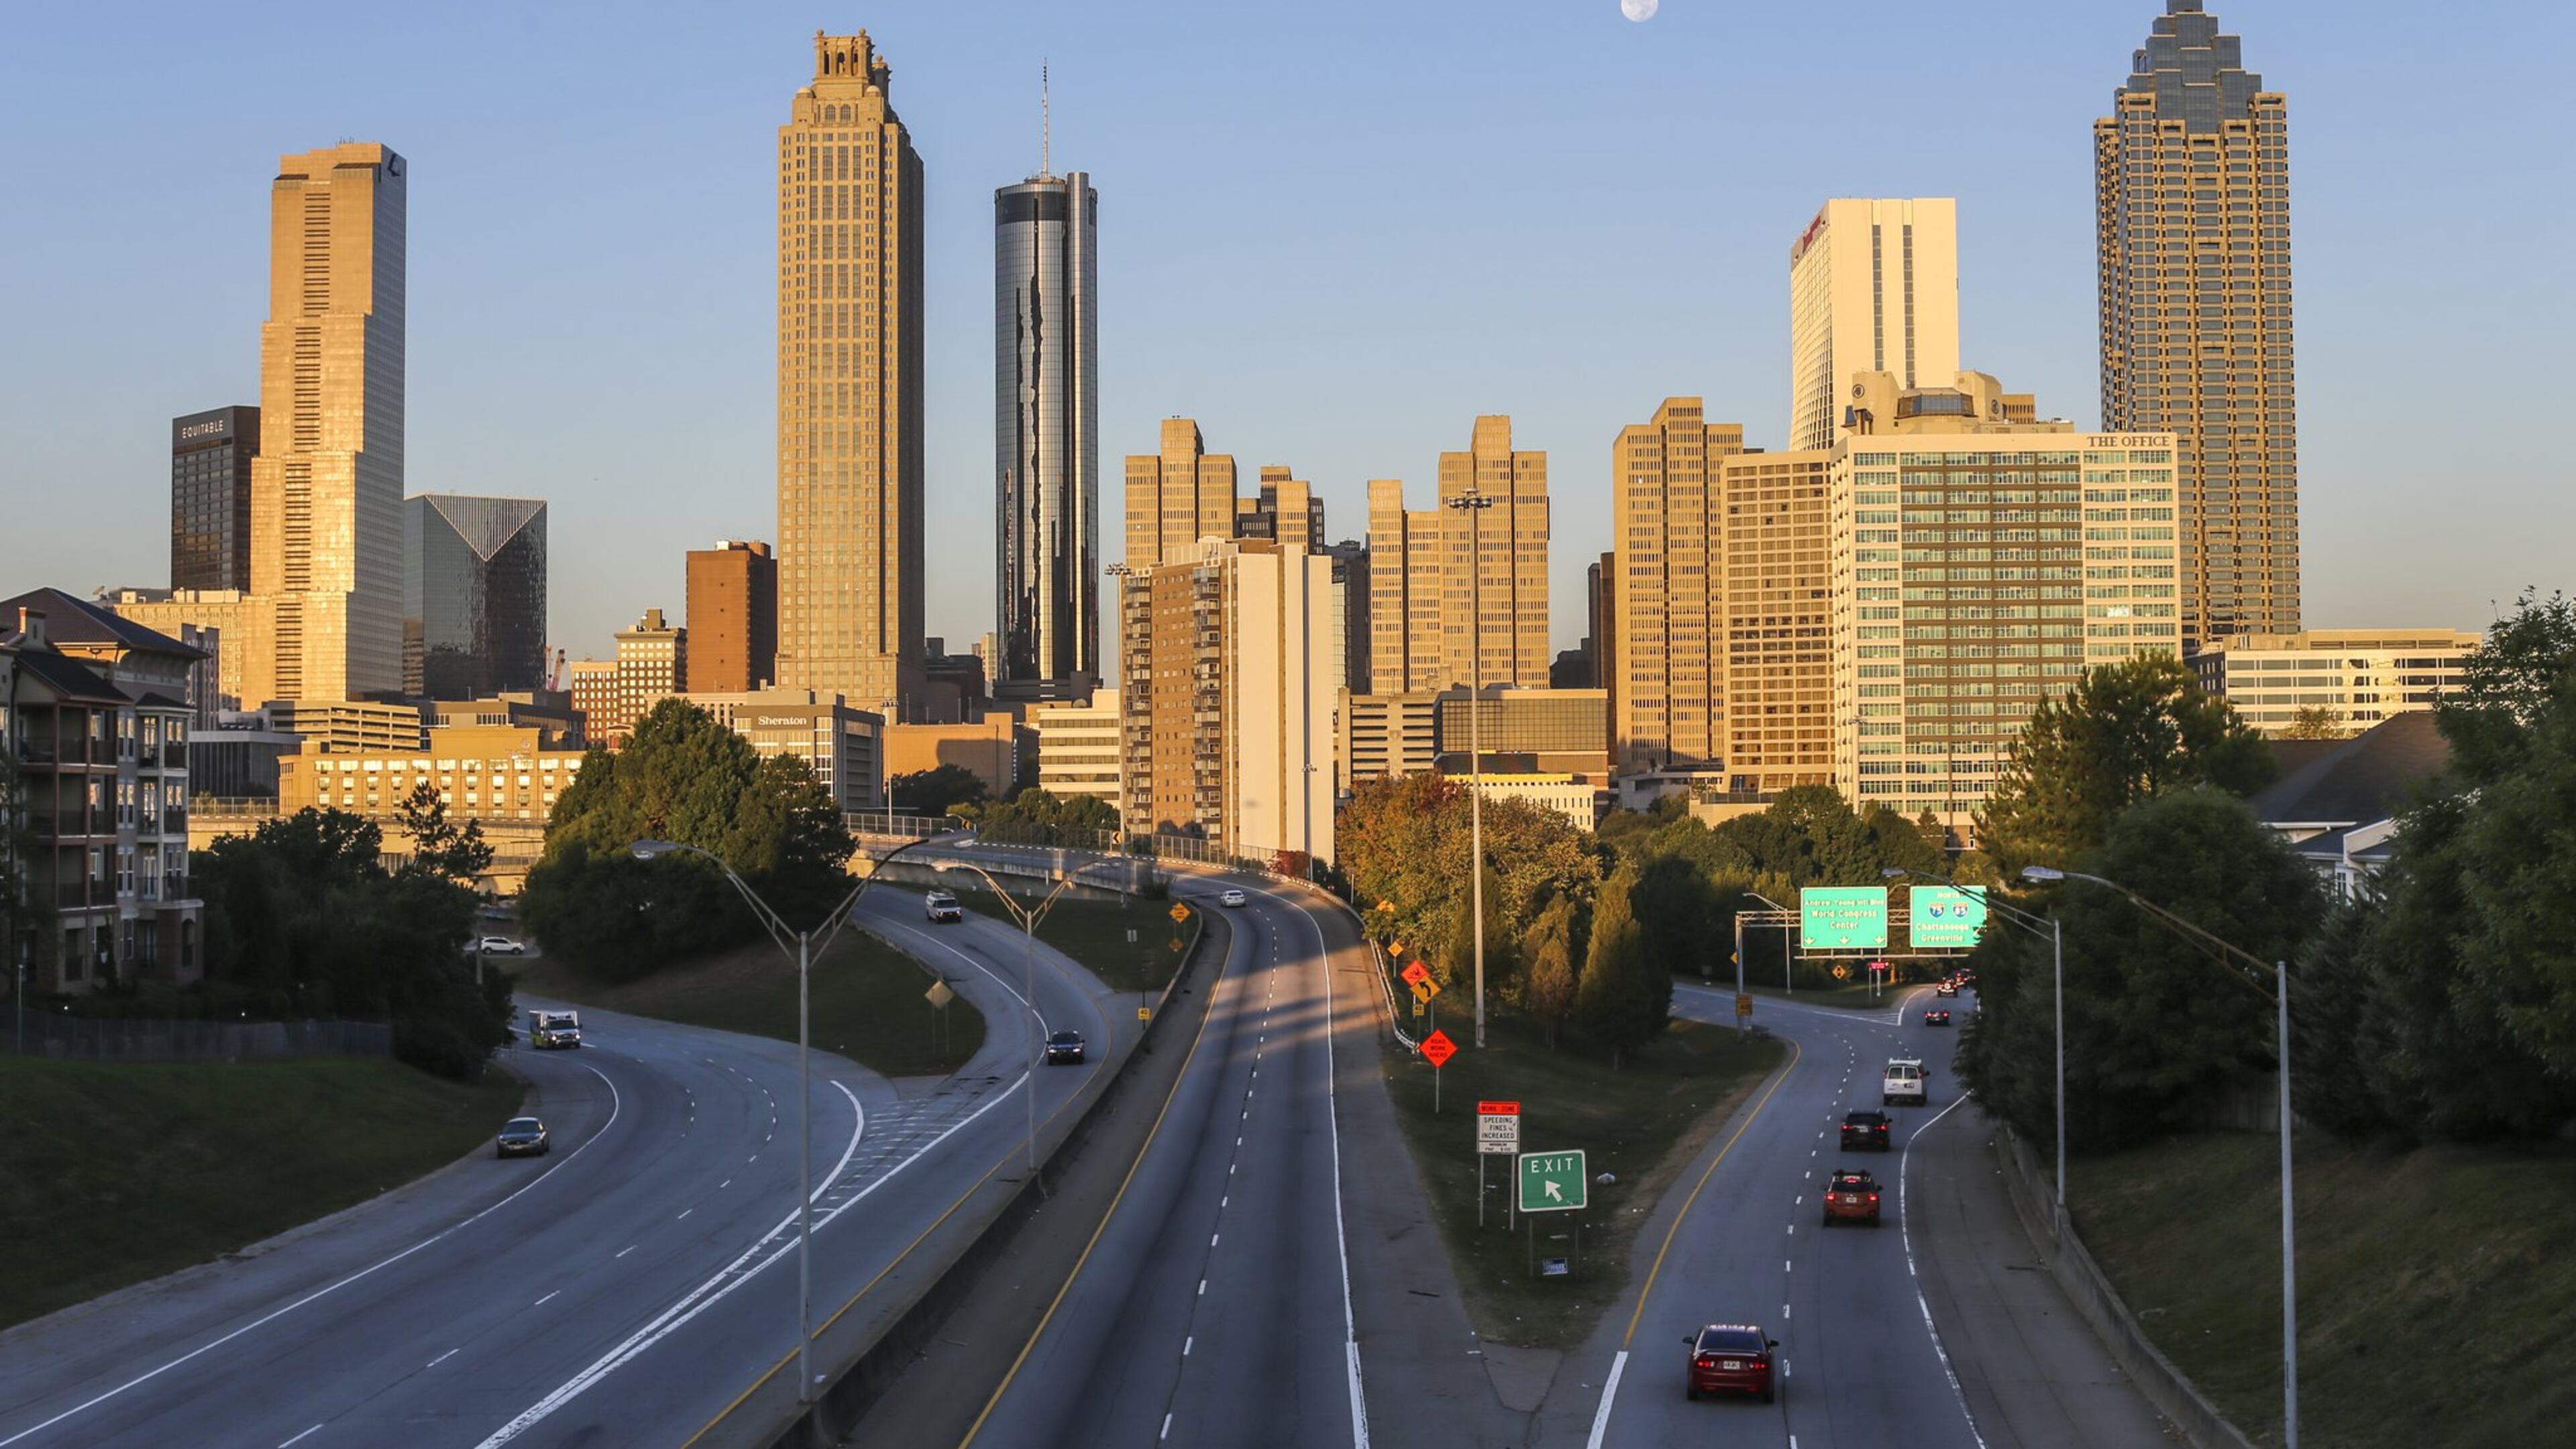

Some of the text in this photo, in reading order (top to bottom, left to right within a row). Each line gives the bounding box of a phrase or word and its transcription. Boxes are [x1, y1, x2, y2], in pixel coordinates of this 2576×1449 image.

[182, 420, 223, 438] EQUITABLE
[2087, 436, 2170, 447] THE OFFICE
[758, 716, 806, 724] Sheraton
[1838, 910, 1877, 919] Congress
[1916, 923, 1969, 932] Chattanooga
[1531, 1158, 1573, 1173] EXIT
